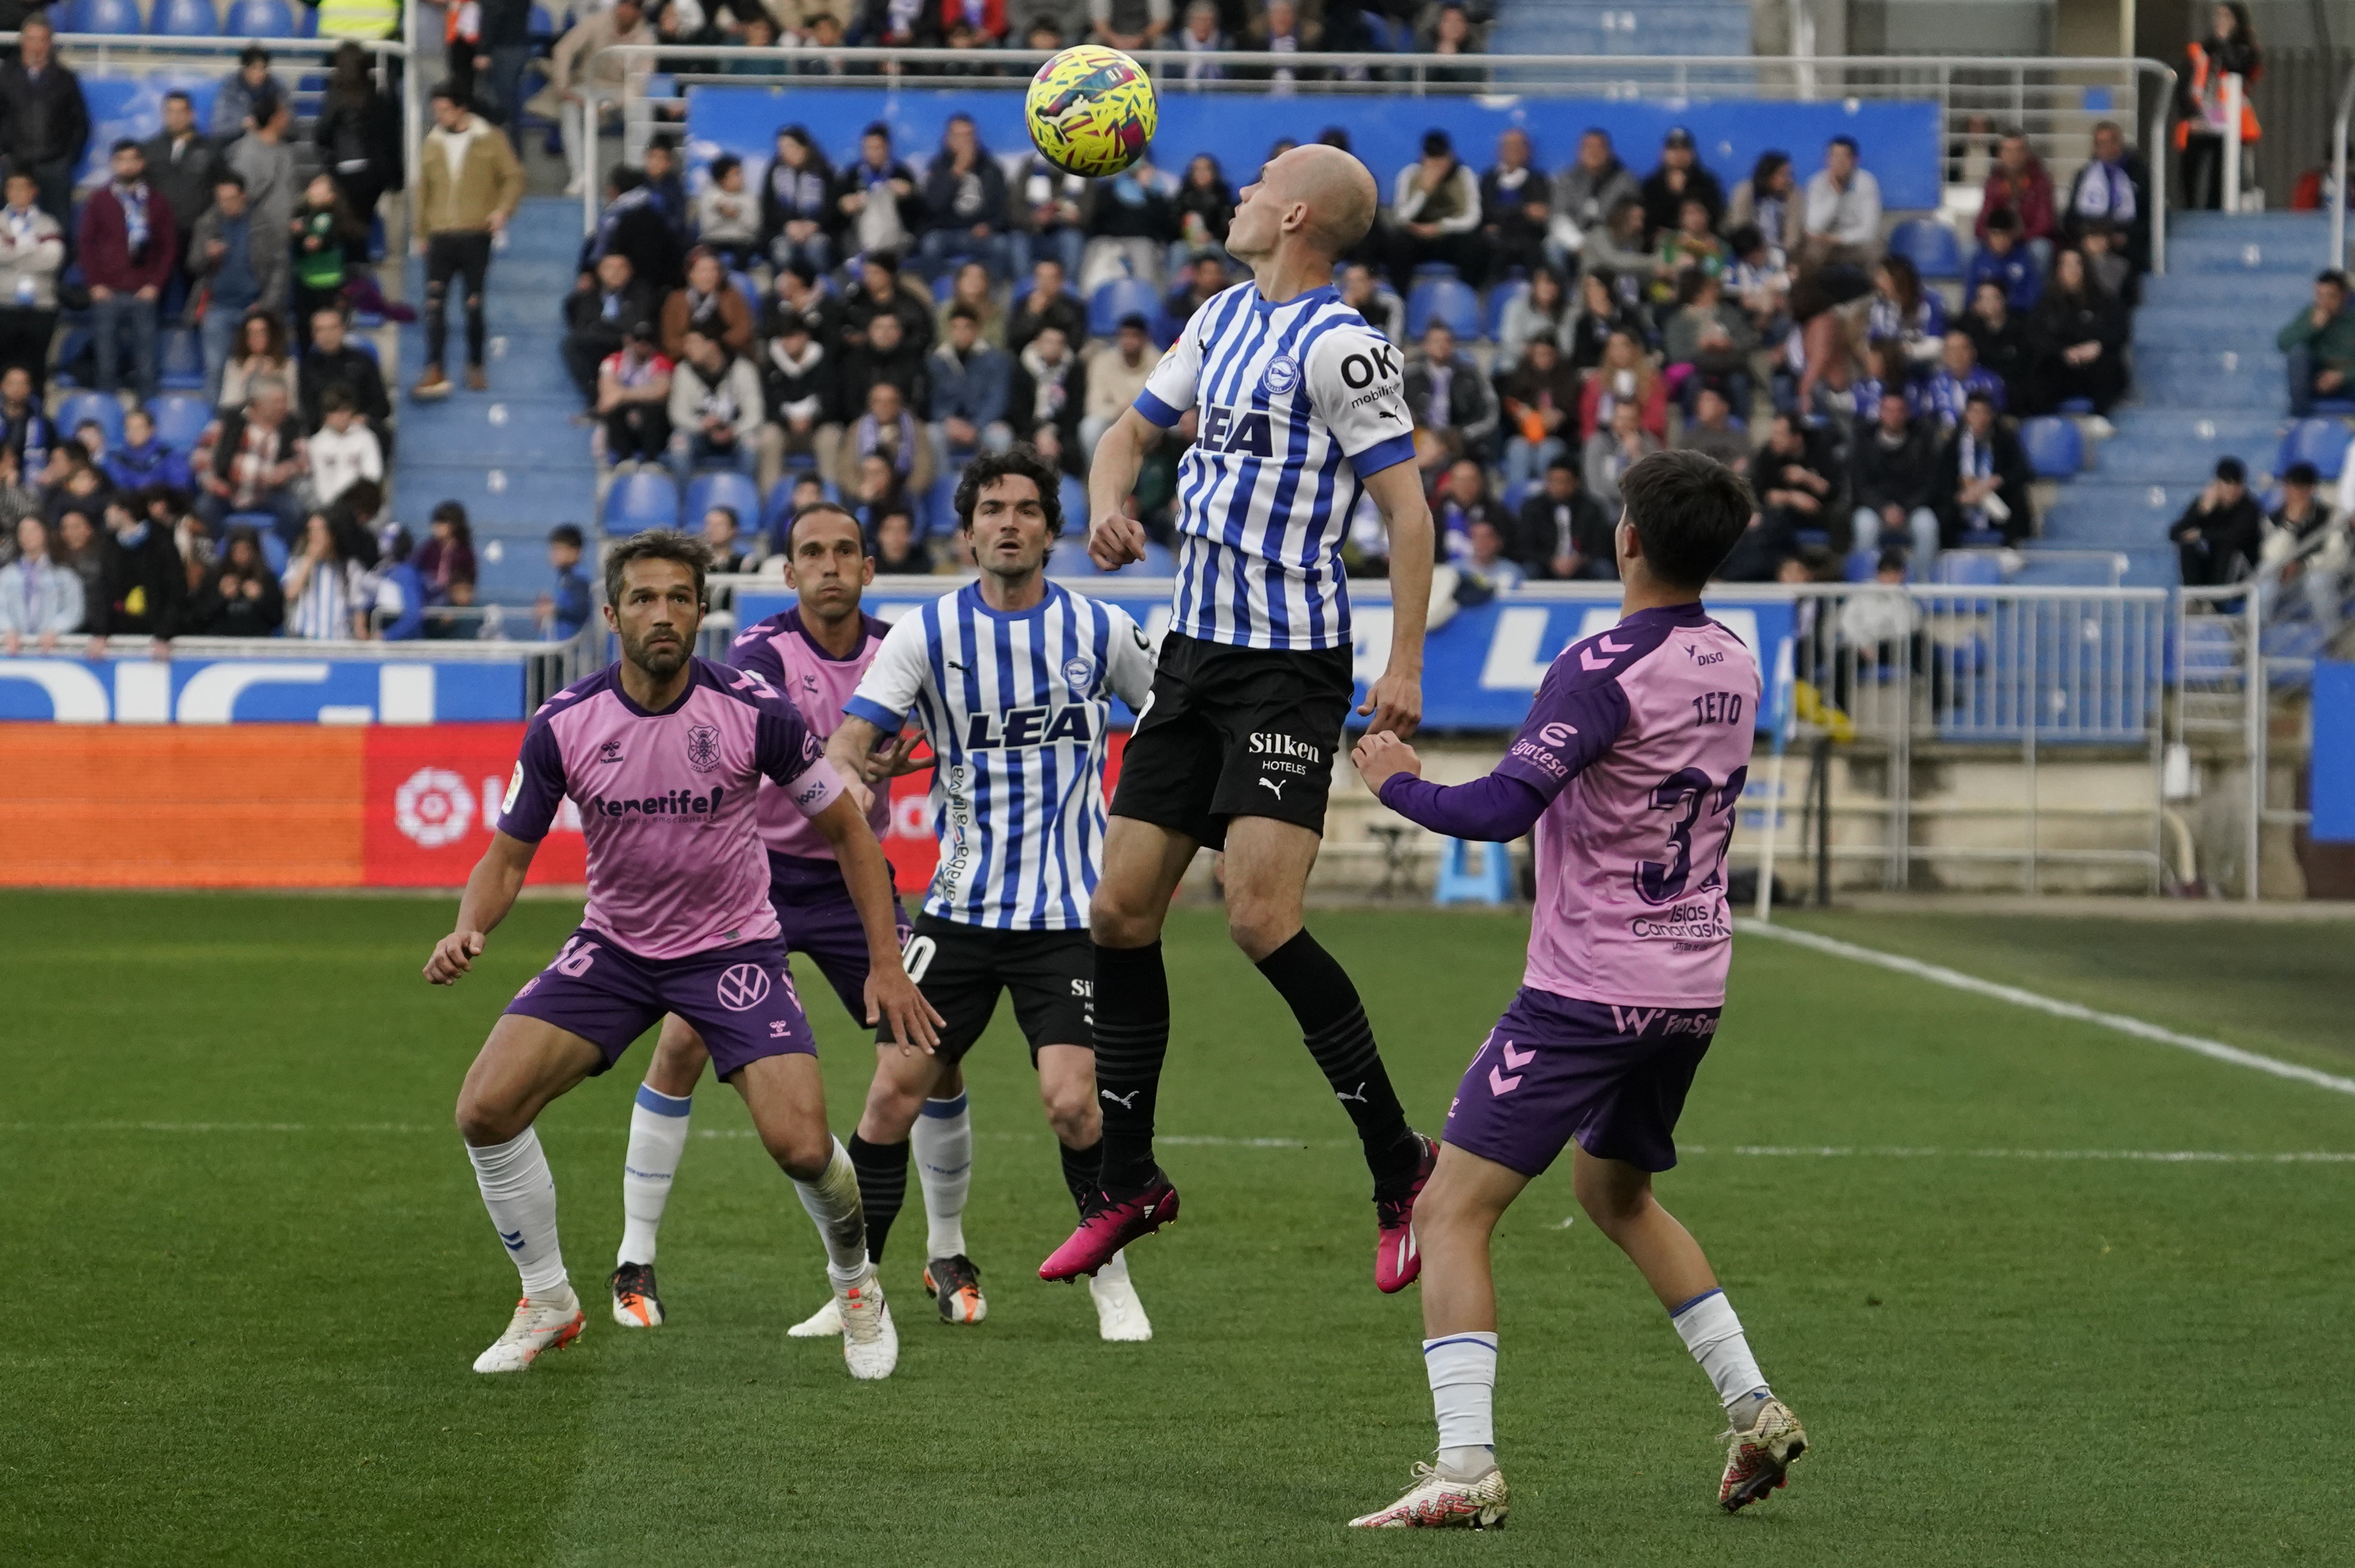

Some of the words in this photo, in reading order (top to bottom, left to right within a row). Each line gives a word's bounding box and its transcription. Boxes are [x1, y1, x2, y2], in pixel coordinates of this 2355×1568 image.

[1341, 344, 1399, 389] OK
[1196, 405, 1274, 458] EA
[965, 704, 1092, 750] LEA
[1692, 691, 1742, 727] TETO
[1249, 732, 1320, 763] Silken
[1262, 760, 1306, 775] HOTELES
[594, 786, 723, 819] tenerife!
[949, 765, 968, 826] álva
[945, 846, 969, 901] araba
[1632, 918, 1712, 939] Canarias
[1670, 904, 1709, 923] Islas
[902, 933, 937, 983] 0
